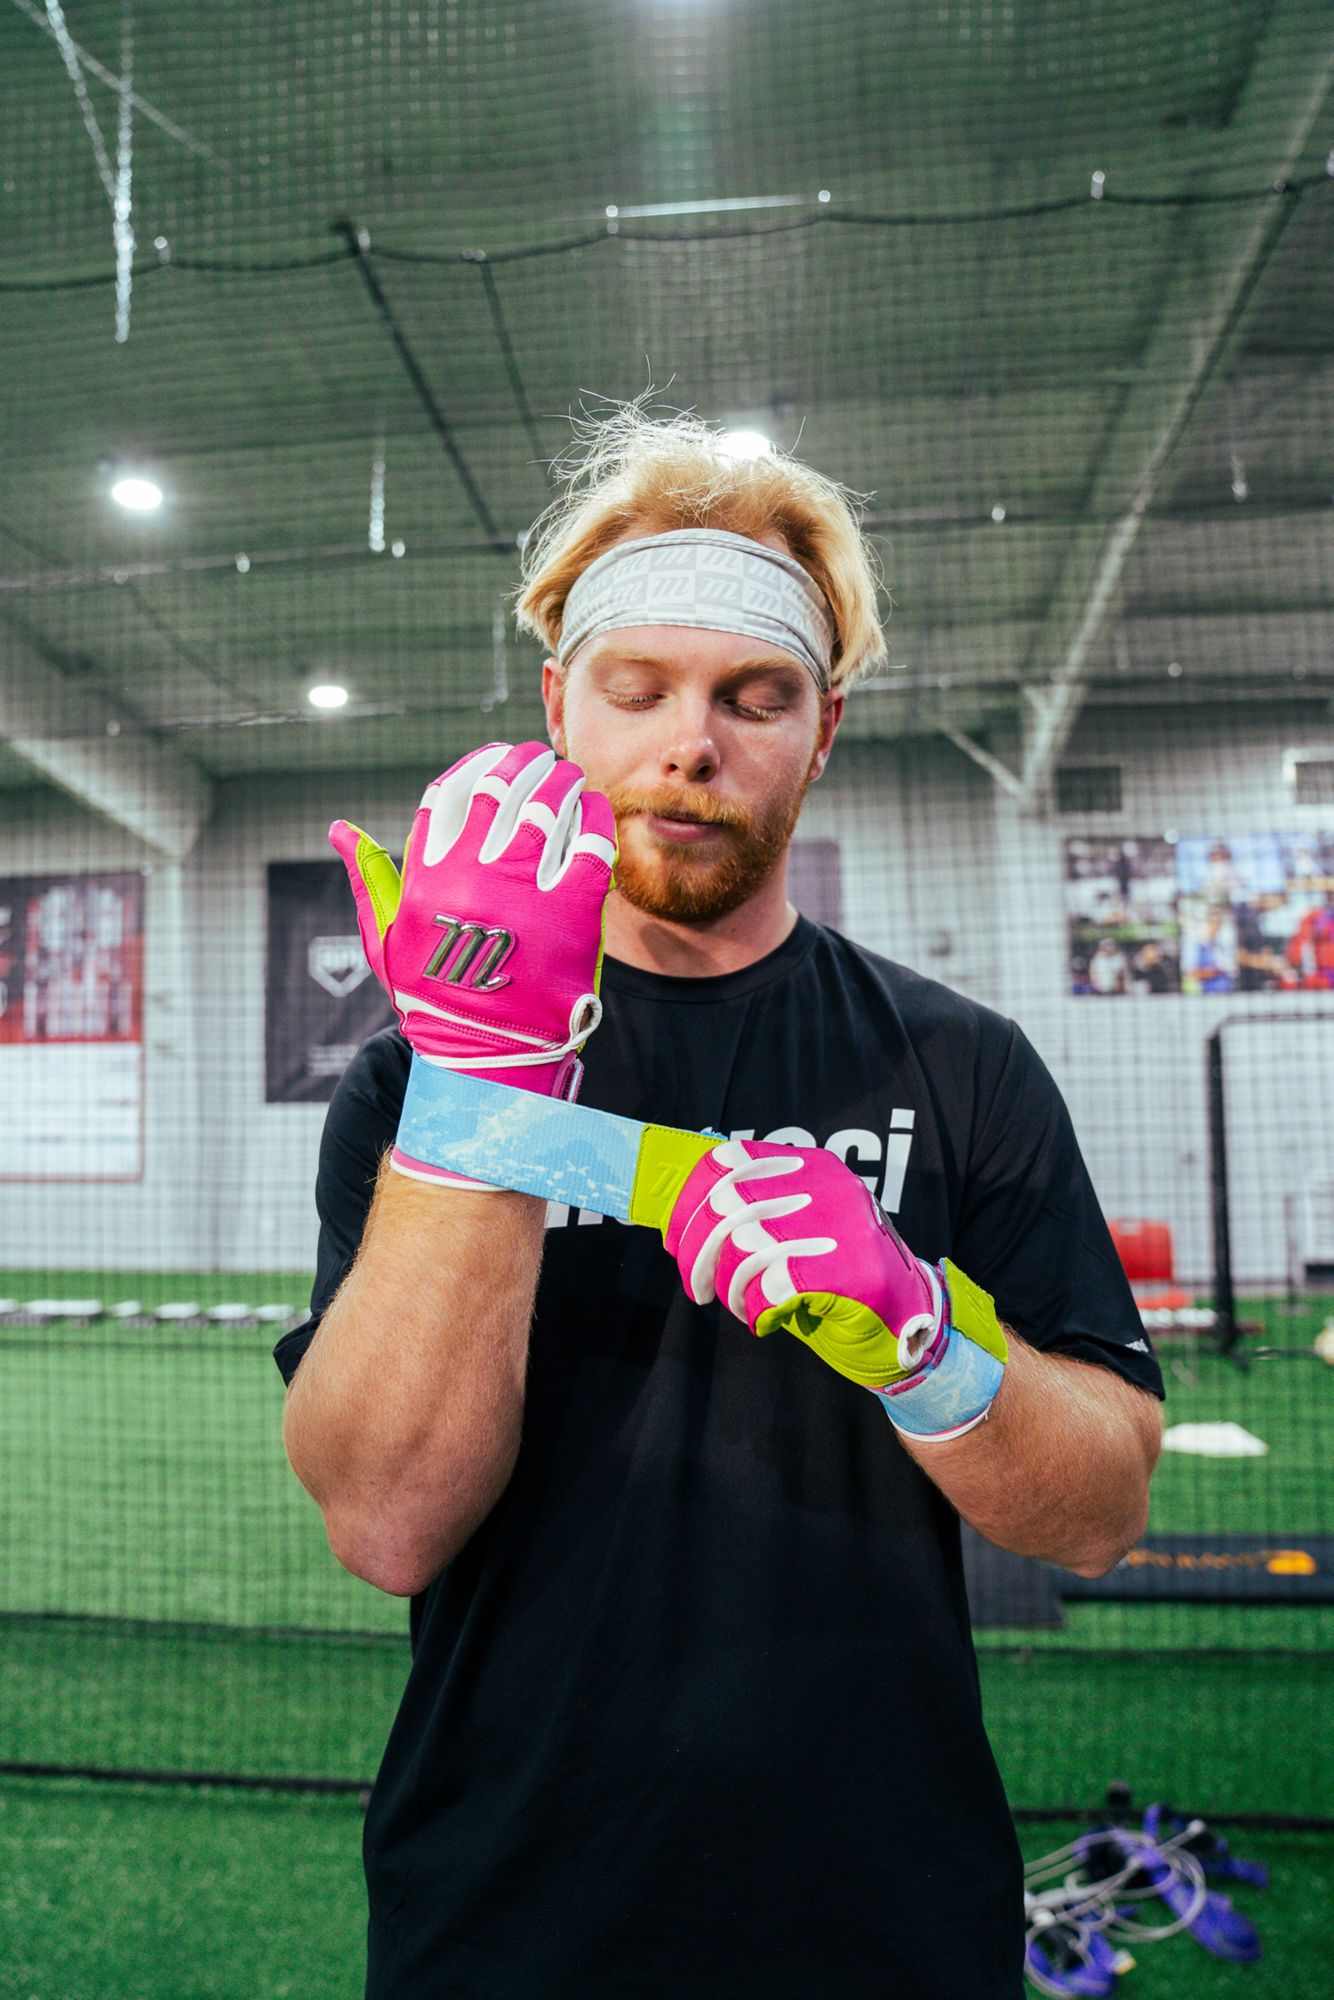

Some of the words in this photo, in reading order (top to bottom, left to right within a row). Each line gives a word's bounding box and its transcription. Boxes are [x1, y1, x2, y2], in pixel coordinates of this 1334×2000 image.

[654, 550, 692, 566] m
[701, 550, 739, 568] m
[652, 577, 690, 597] m
[701, 578, 739, 600] m
[751, 588, 780, 611] m
[421, 912, 513, 992] m
